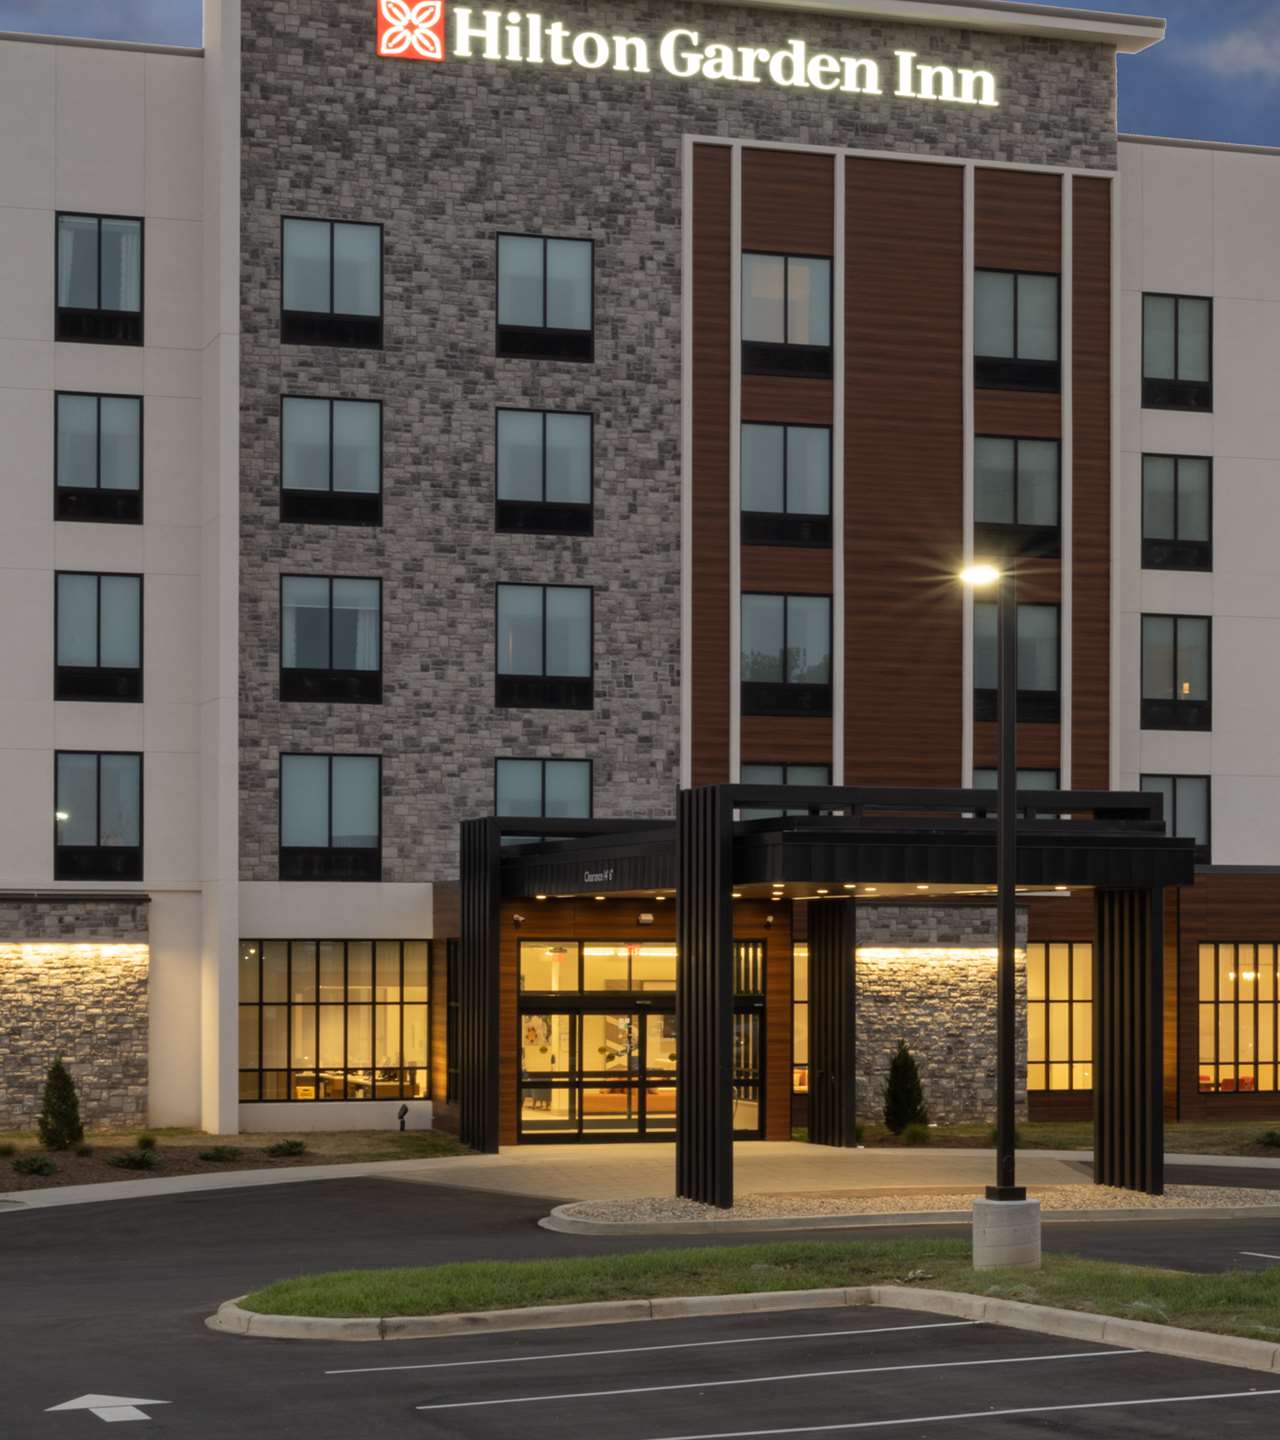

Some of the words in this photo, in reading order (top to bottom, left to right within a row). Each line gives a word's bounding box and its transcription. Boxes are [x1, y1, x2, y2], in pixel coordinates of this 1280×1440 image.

[453, 7, 651, 72] Hilton
[659, 28, 883, 95] Garden
[894, 50, 998, 107] Inn
